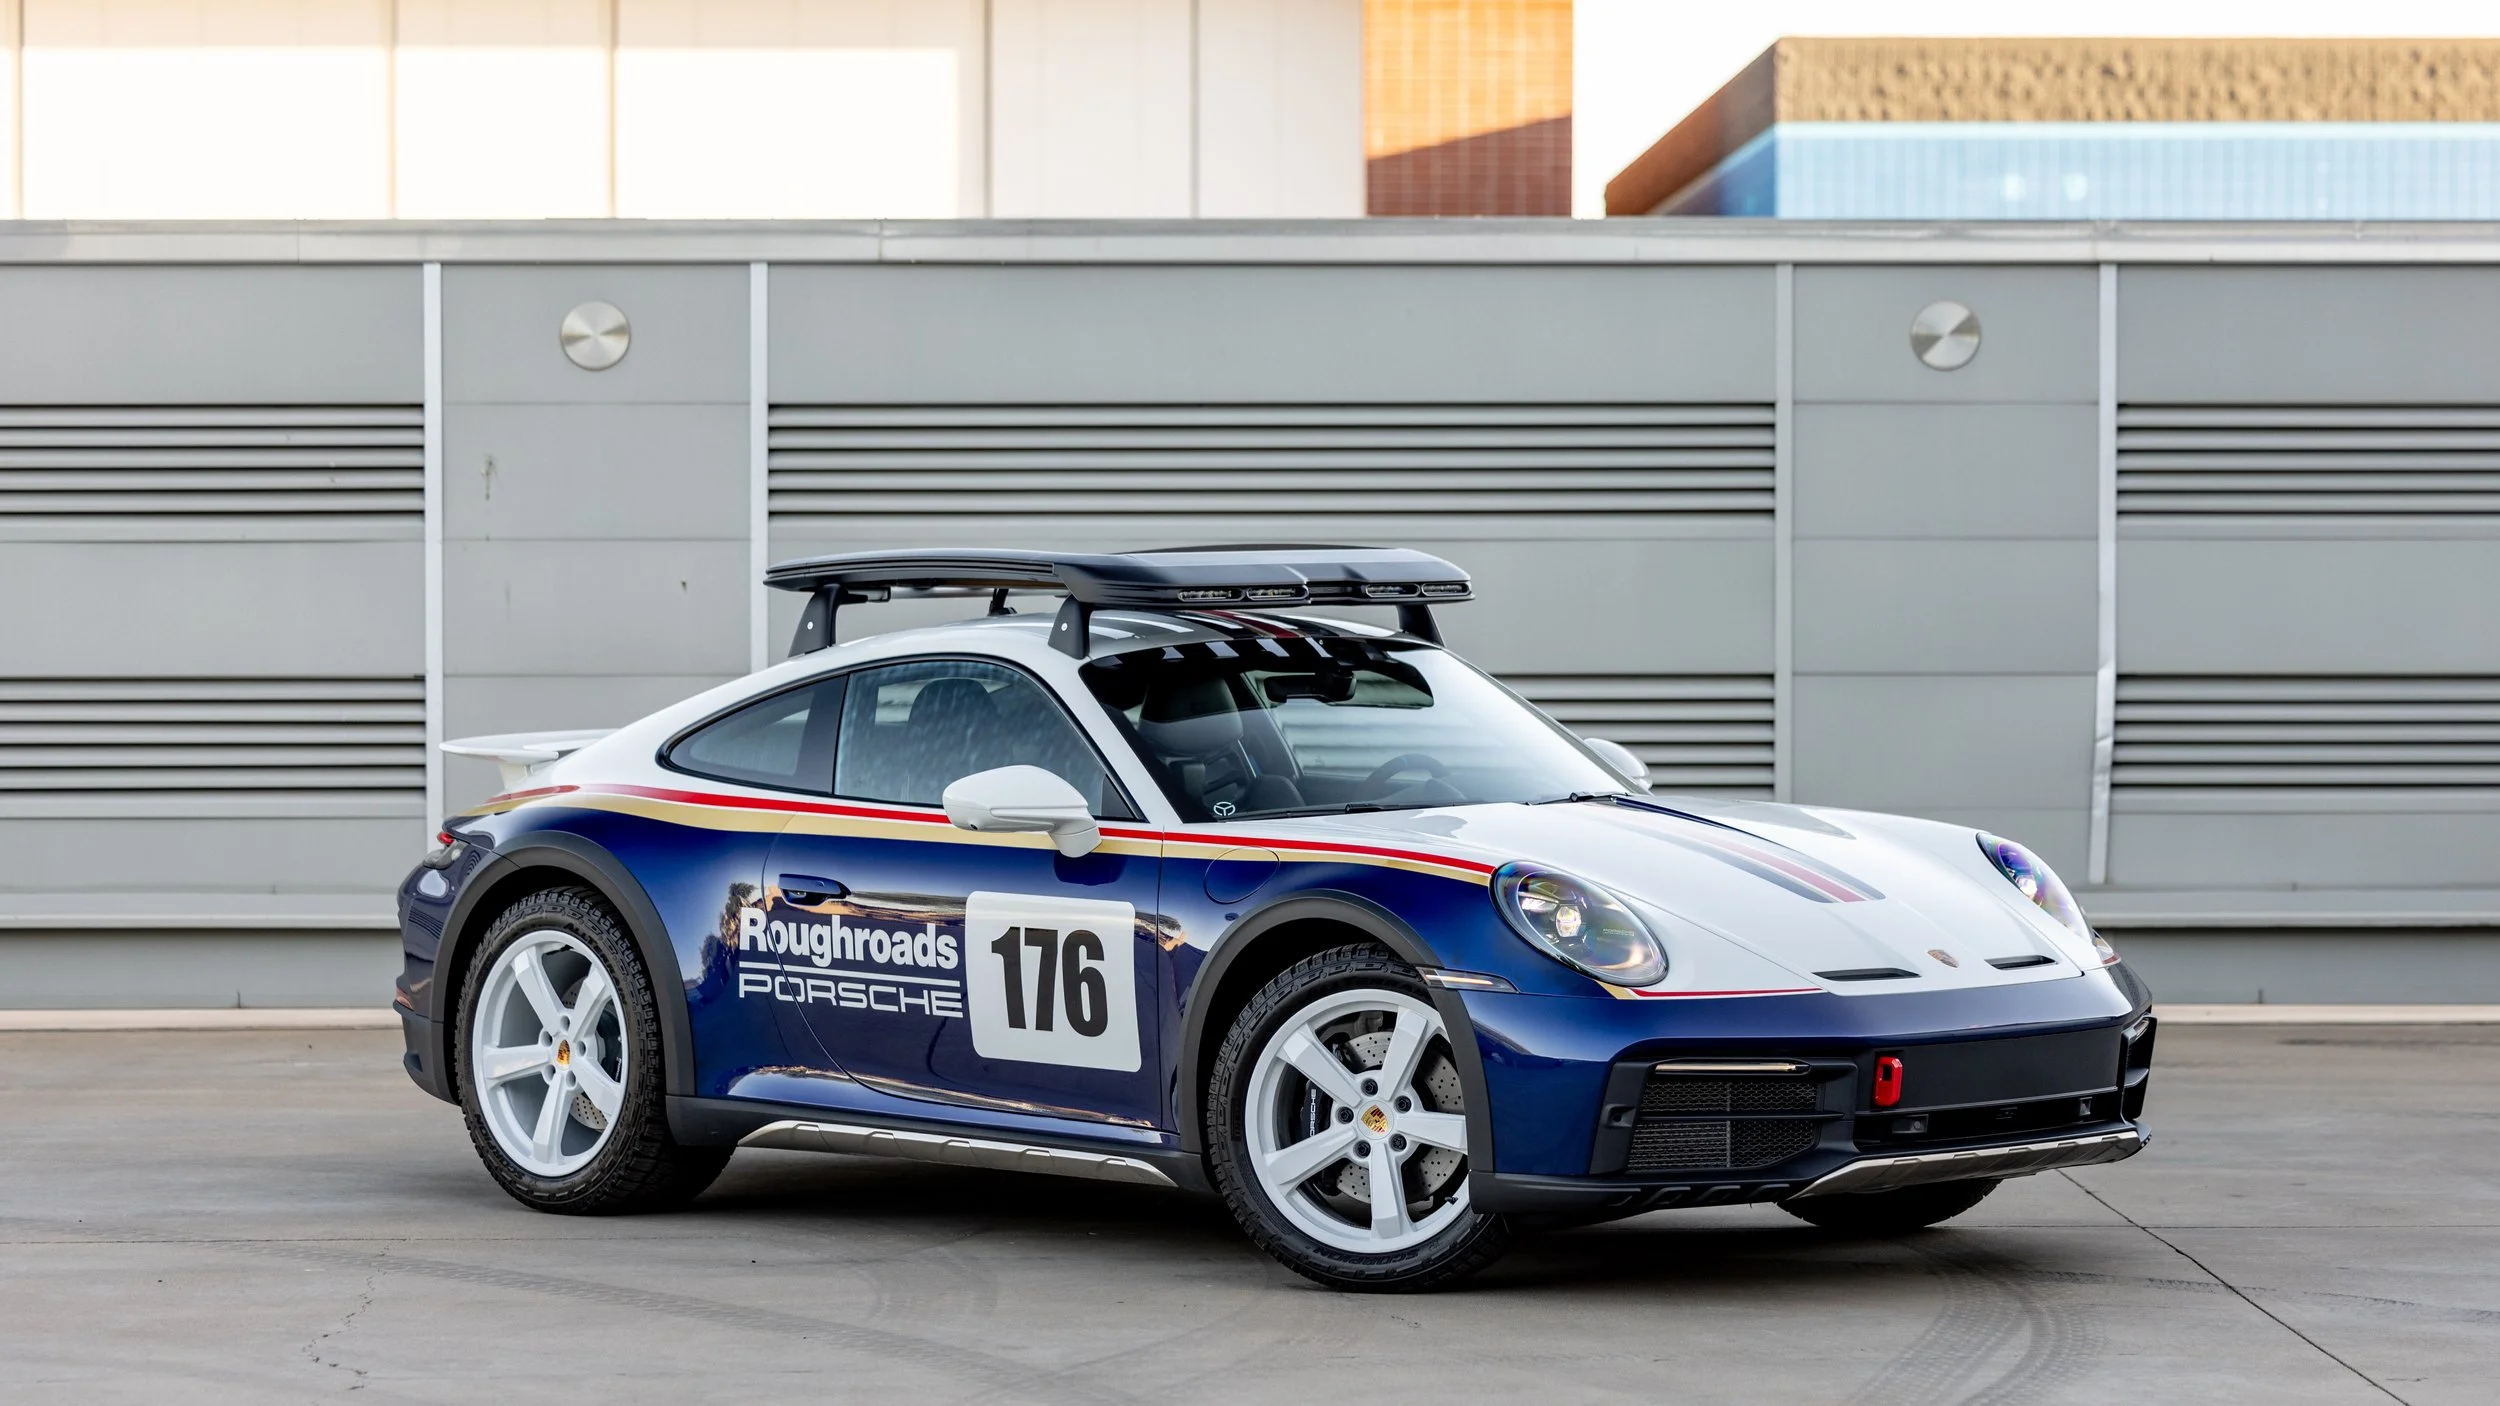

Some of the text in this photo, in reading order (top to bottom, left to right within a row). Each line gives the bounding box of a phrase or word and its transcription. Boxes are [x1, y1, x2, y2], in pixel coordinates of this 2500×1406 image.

[739, 907, 959, 969] Roughroads
[739, 973, 963, 1018] PORSCHE
[991, 926, 1108, 1037] 176
[1309, 1088, 1317, 1137] ORSCHE
